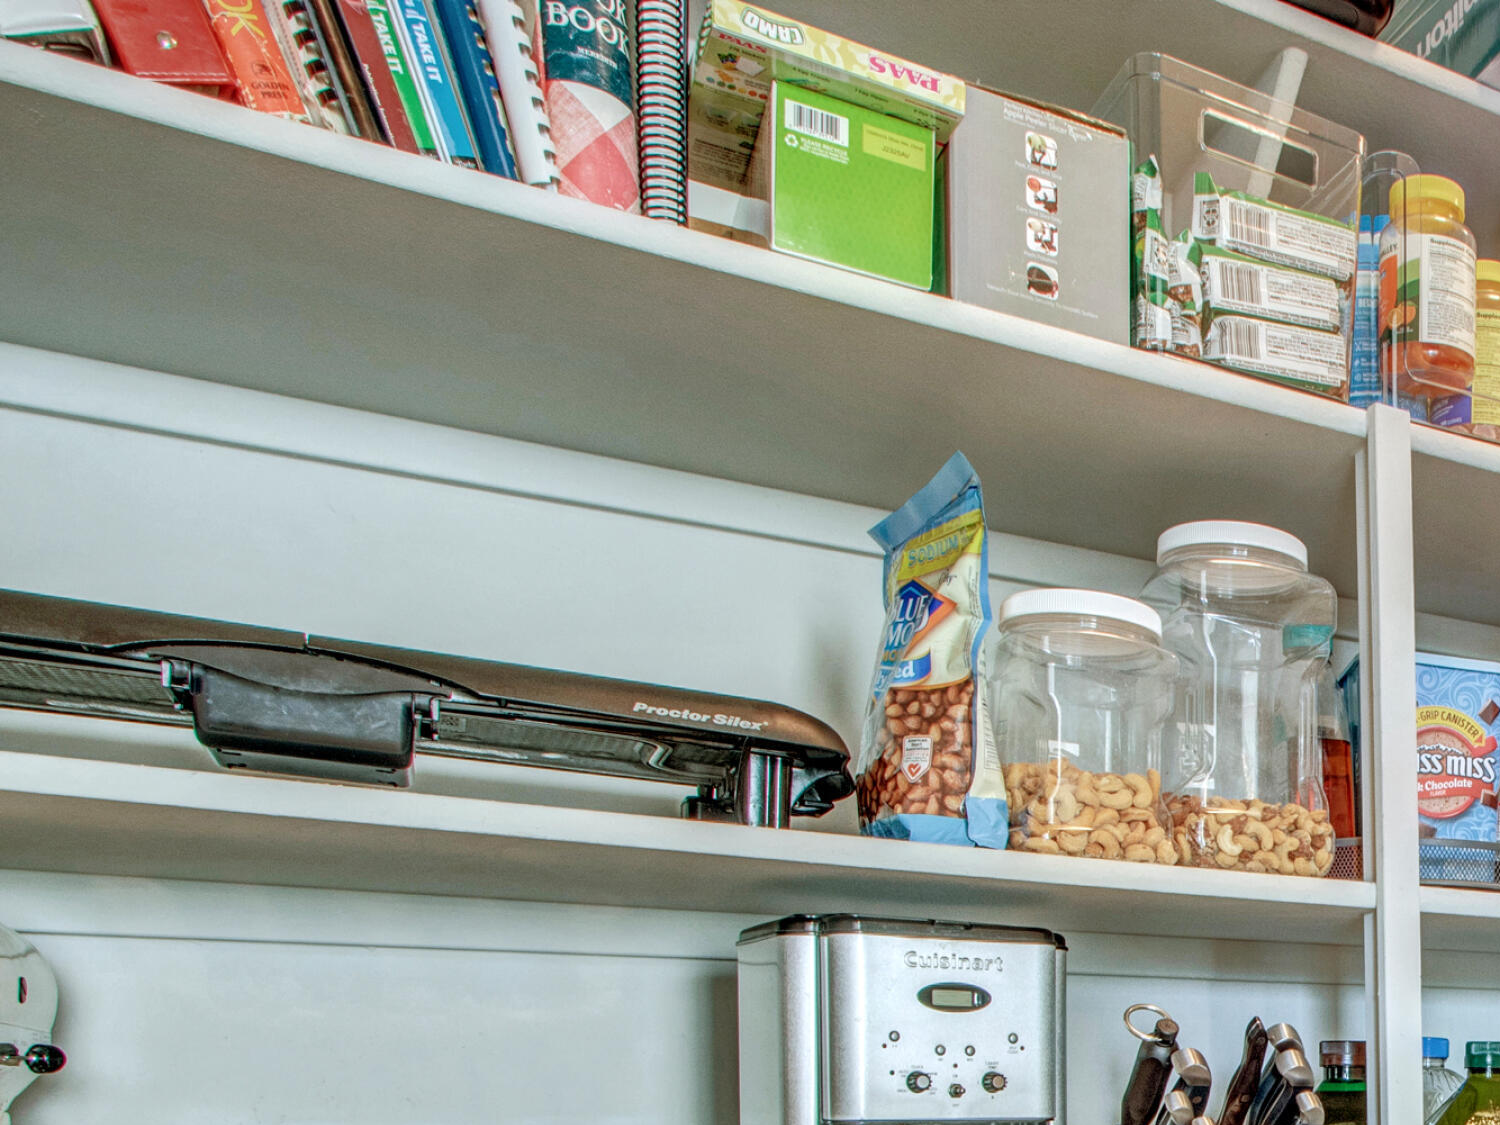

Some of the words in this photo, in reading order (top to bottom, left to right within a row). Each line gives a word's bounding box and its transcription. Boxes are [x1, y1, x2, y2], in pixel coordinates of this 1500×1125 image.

[372, 12, 398, 55] TAKE
[388, 55, 404, 75] IT
[548, 2, 630, 55] BOOK
[743, 9, 803, 46] CAMO
[411, 23, 437, 65] TAKE
[425, 63, 443, 85] IT
[251, 81, 290, 93] GOLDEN
[868, 54, 942, 94] PAAS
[633, 702, 711, 722] Proctor
[713, 713, 763, 731] Silex
[1440, 711, 1480, 739] CANISTER
[1425, 778, 1473, 792] Chocolate
[904, 950, 1004, 972] Cuisinart
